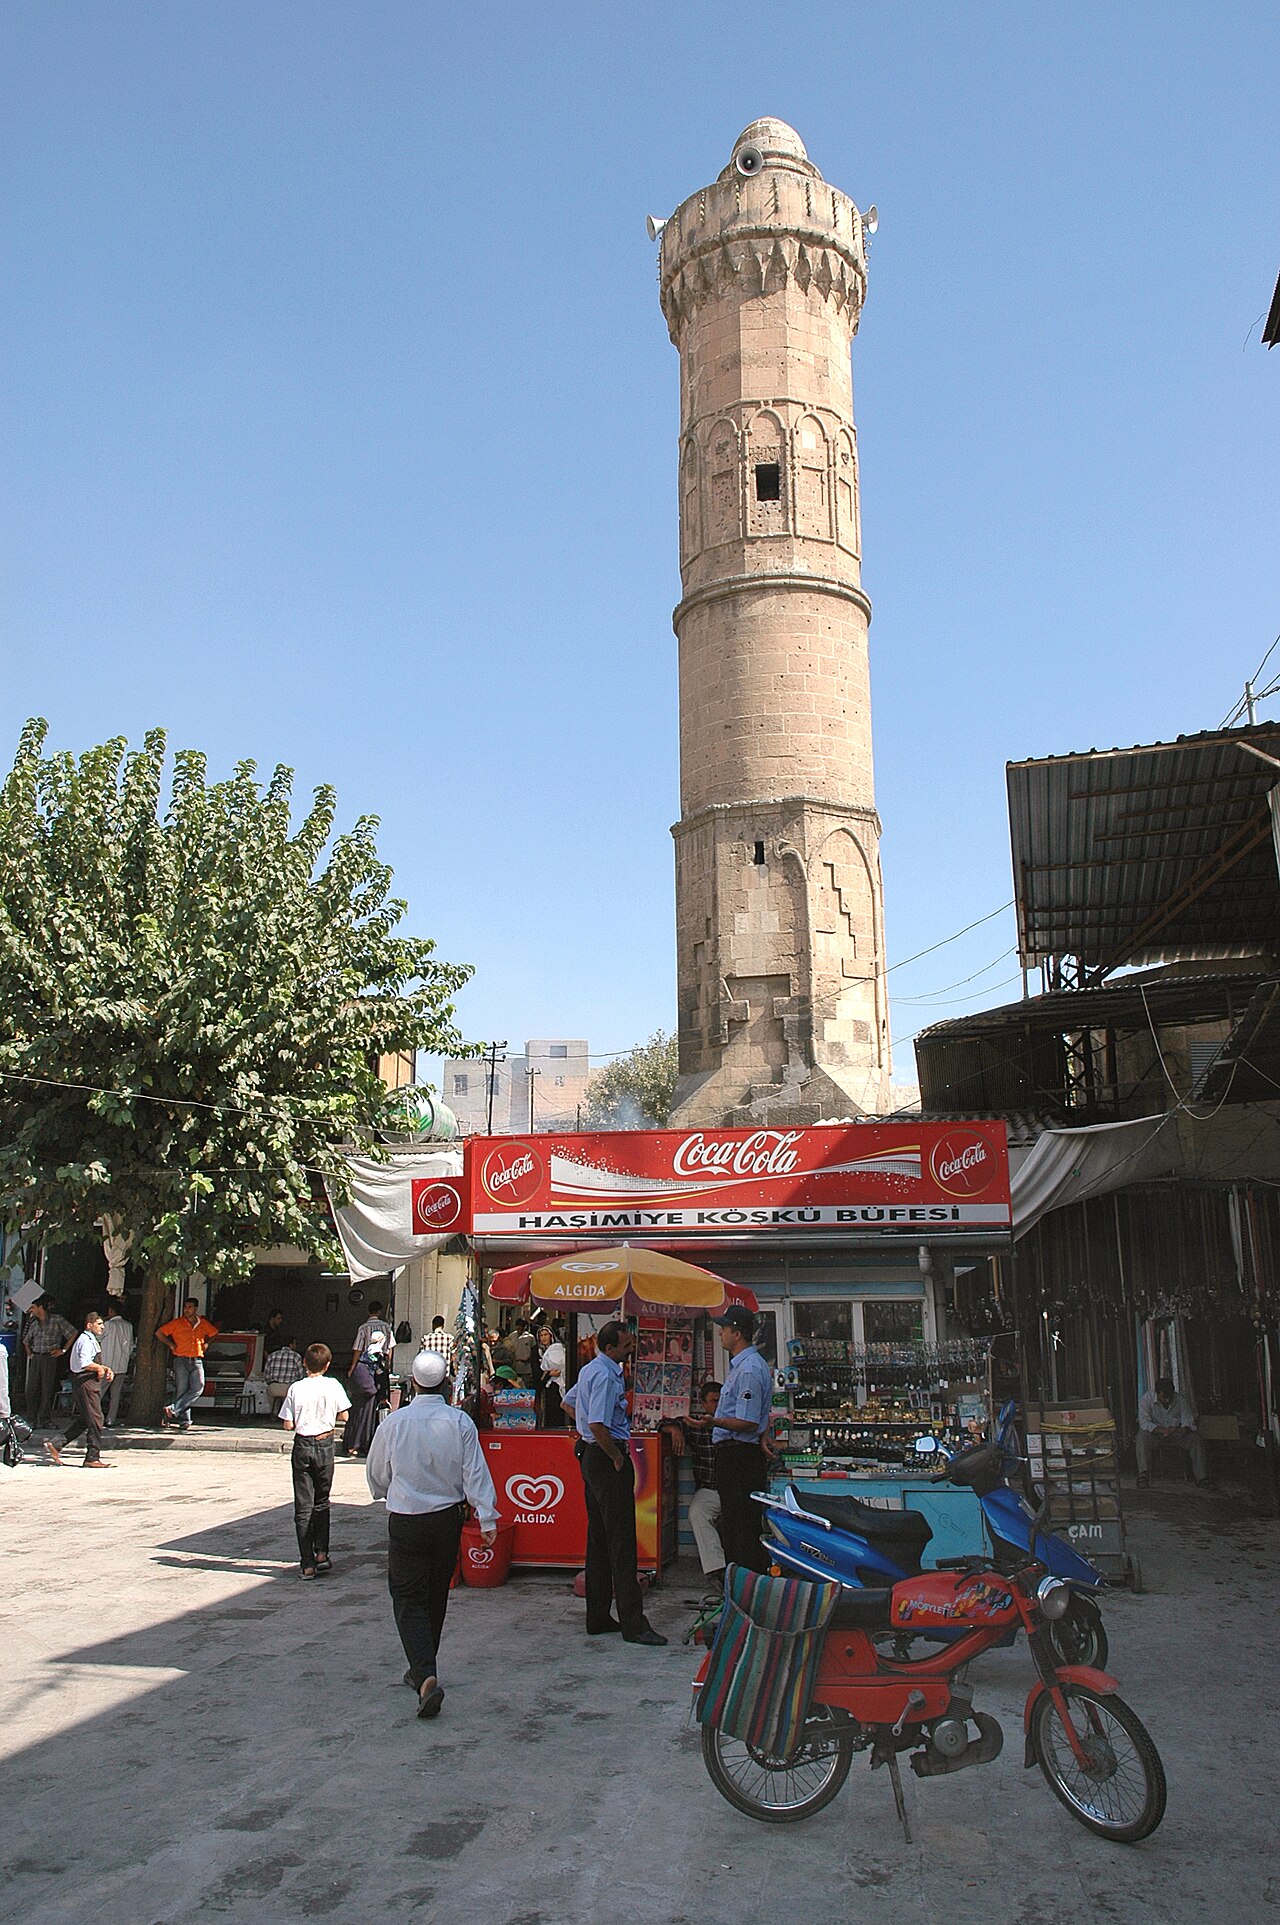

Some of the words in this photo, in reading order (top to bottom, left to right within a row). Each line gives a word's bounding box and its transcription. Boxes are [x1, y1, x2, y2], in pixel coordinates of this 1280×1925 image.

[673, 1130, 805, 1176] Coca-Cola
[939, 1140, 986, 1181] Coca-Cola
[490, 1152, 534, 1191] Coca-Cola
[519, 1210, 683, 1229] HAŞİMİYE
[697, 1207, 821, 1225] KÖŞKÜ
[836, 1204, 960, 1221] BÜFESİ
[554, 1284, 607, 1297] ALGIDA
[513, 1513, 556, 1524] ALGIDA
